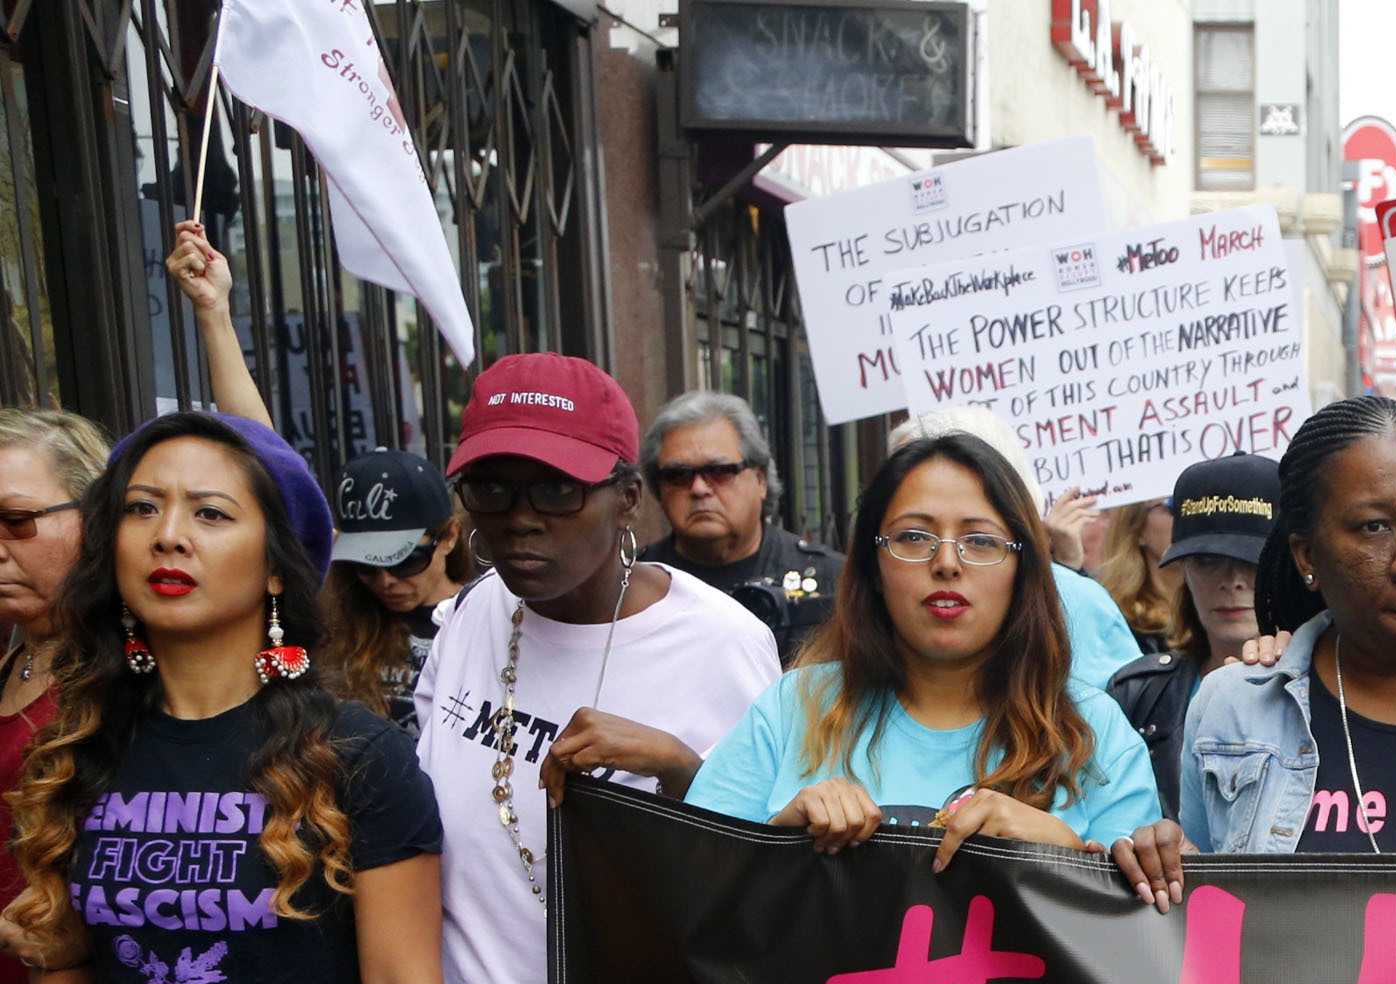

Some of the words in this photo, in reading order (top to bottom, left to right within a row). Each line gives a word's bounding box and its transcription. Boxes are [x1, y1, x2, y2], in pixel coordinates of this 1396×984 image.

[321, 49, 401, 136] Stronger
[811, 234, 869, 272] THE
[884, 190, 1065, 255] SUBJUGATION
[1199, 225, 1264, 260] MARCH
[845, 280, 883, 306] OF
[909, 322, 960, 360] THE
[970, 304, 1065, 353] POWER
[1073, 281, 1212, 330] STRUCTURE
[925, 355, 1036, 402] WOMEN
[1059, 343, 1100, 375] OUT
[1108, 338, 1135, 367] OF
[1139, 329, 1175, 357] THE
[1178, 303, 1289, 352] NARRATIVE
[1010, 391, 1038, 418] OF
[1045, 380, 1097, 409] THIS
[1107, 358, 1213, 398] COUNTRY
[1219, 342, 1302, 377] THROUGH
[488, 393, 506, 406] NOT
[511, 392, 575, 412] INTERESTED
[1014, 405, 1118, 449] SMENT
[1138, 378, 1266, 430] ASSAULT
[1033, 446, 1091, 485] BUT
[1199, 406, 1294, 459] OVER
[338, 477, 397, 520] Cali
[441, 687, 562, 765] #MET
[85, 791, 272, 834] EMINIST
[1308, 789, 1387, 833] me
[88, 837, 247, 885] FIGHT
